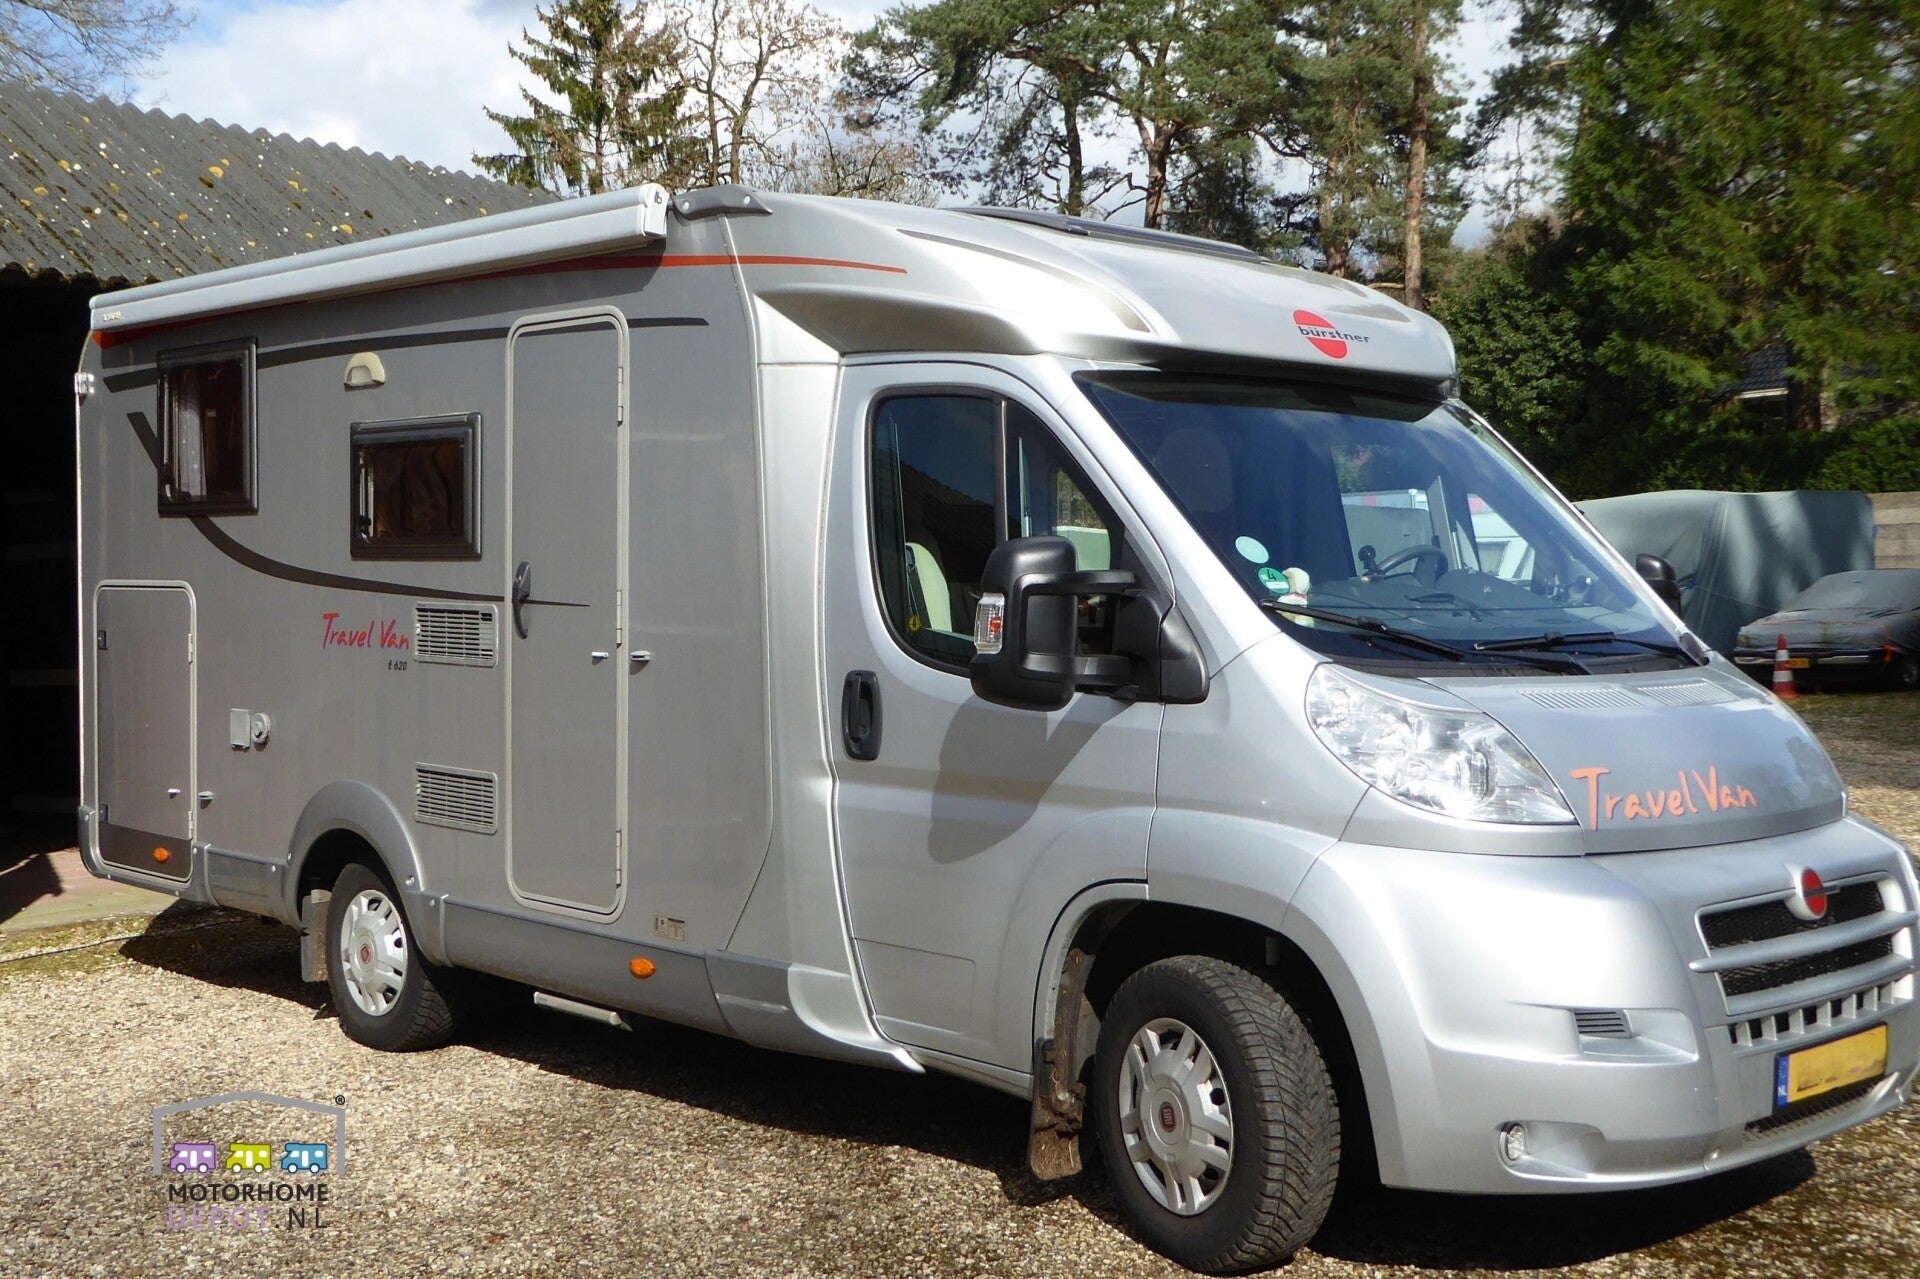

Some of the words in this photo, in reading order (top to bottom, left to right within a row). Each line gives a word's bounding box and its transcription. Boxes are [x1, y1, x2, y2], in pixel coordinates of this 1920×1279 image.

[1298, 326, 1370, 342] bürstner
[1266, 569, 1278, 581] 4
[323, 612, 375, 650] Travel
[380, 619, 409, 650] Van
[394, 661, 408, 671] 620
[1569, 767, 1698, 832] Travel
[1691, 764, 1758, 813] Van
